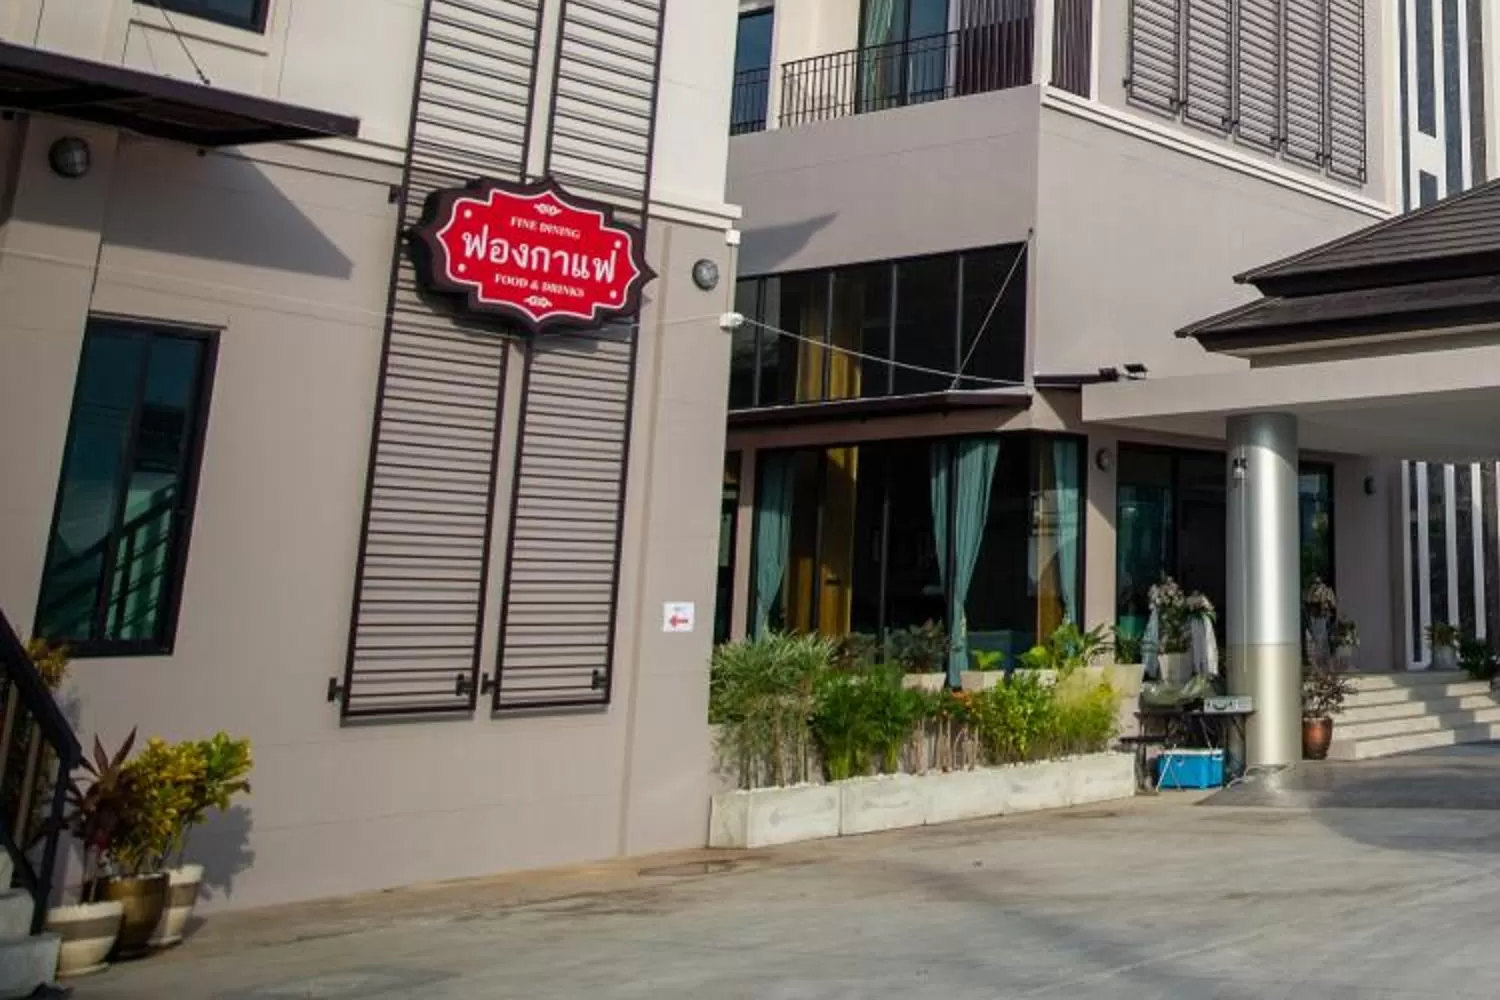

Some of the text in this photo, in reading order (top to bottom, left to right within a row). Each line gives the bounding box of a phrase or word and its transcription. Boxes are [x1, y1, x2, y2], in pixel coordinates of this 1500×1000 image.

[510, 215, 581, 240] FINE DINING
[461, 223, 618, 284] ฟองกาแฟ
[495, 272, 529, 288] FOOD
[541, 281, 585, 298] DRINKS
